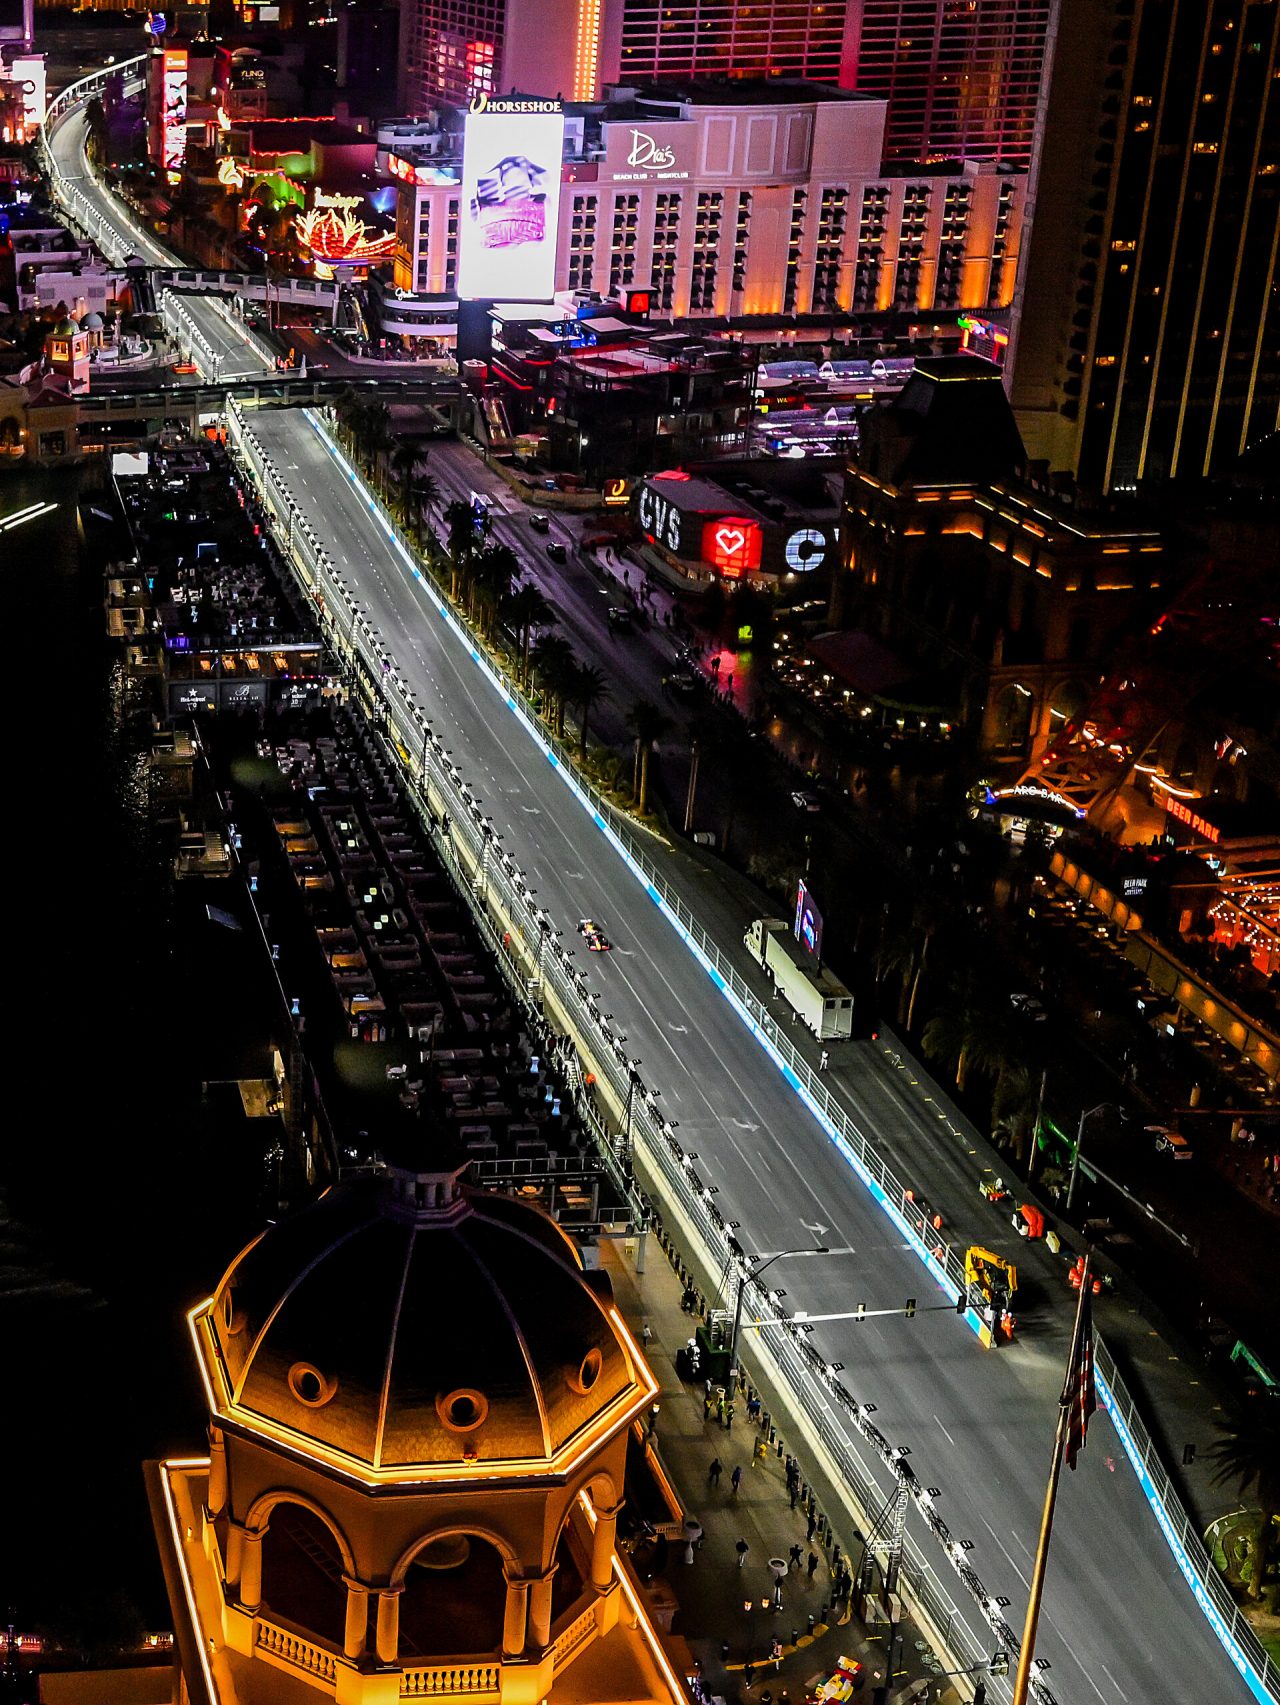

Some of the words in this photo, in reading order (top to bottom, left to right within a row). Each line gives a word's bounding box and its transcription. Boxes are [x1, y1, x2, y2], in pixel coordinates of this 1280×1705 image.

[487, 101, 562, 112] HORSESHOE
[627, 128, 675, 169] Drai's
[639, 487, 681, 551] CVS
[1166, 797, 1193, 825] BEER
[1191, 814, 1220, 844] PARK
[1149, 1497, 1194, 1585] AMERICAN
[1195, 1584, 1247, 1674] EXPRESS
